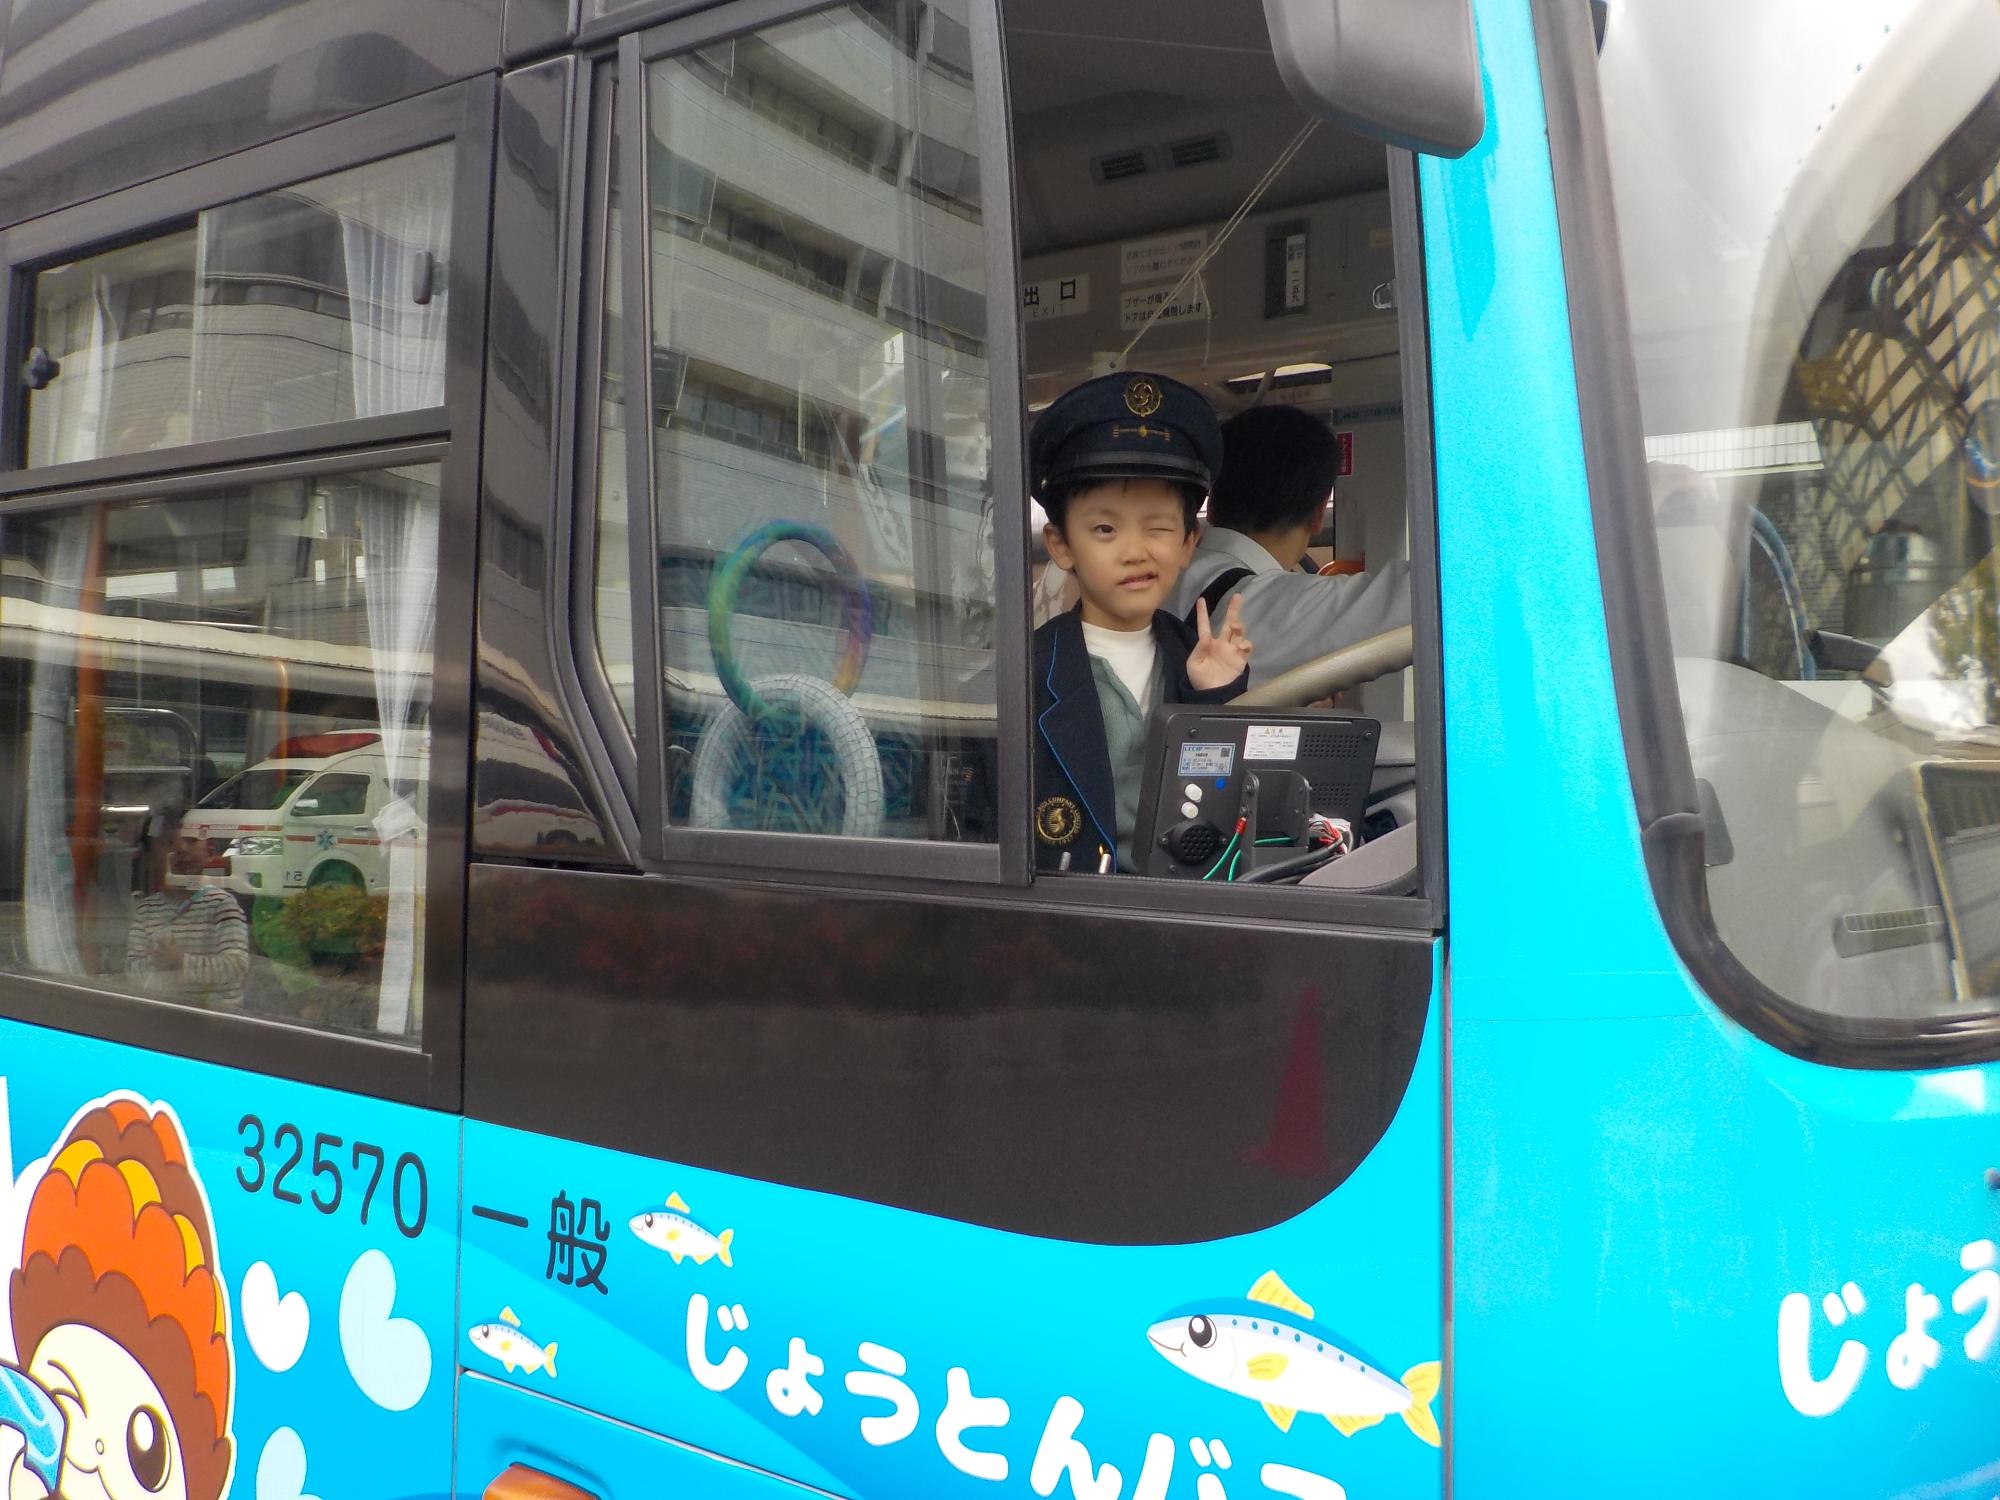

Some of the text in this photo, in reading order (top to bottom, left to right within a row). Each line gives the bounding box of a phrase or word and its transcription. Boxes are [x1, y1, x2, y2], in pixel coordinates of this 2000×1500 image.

[1024, 279, 1076, 307] 出口
[1033, 304, 1064, 317] EXIT
[236, 1113, 428, 1238] 32570
[472, 1190, 610, 1295] 一般
